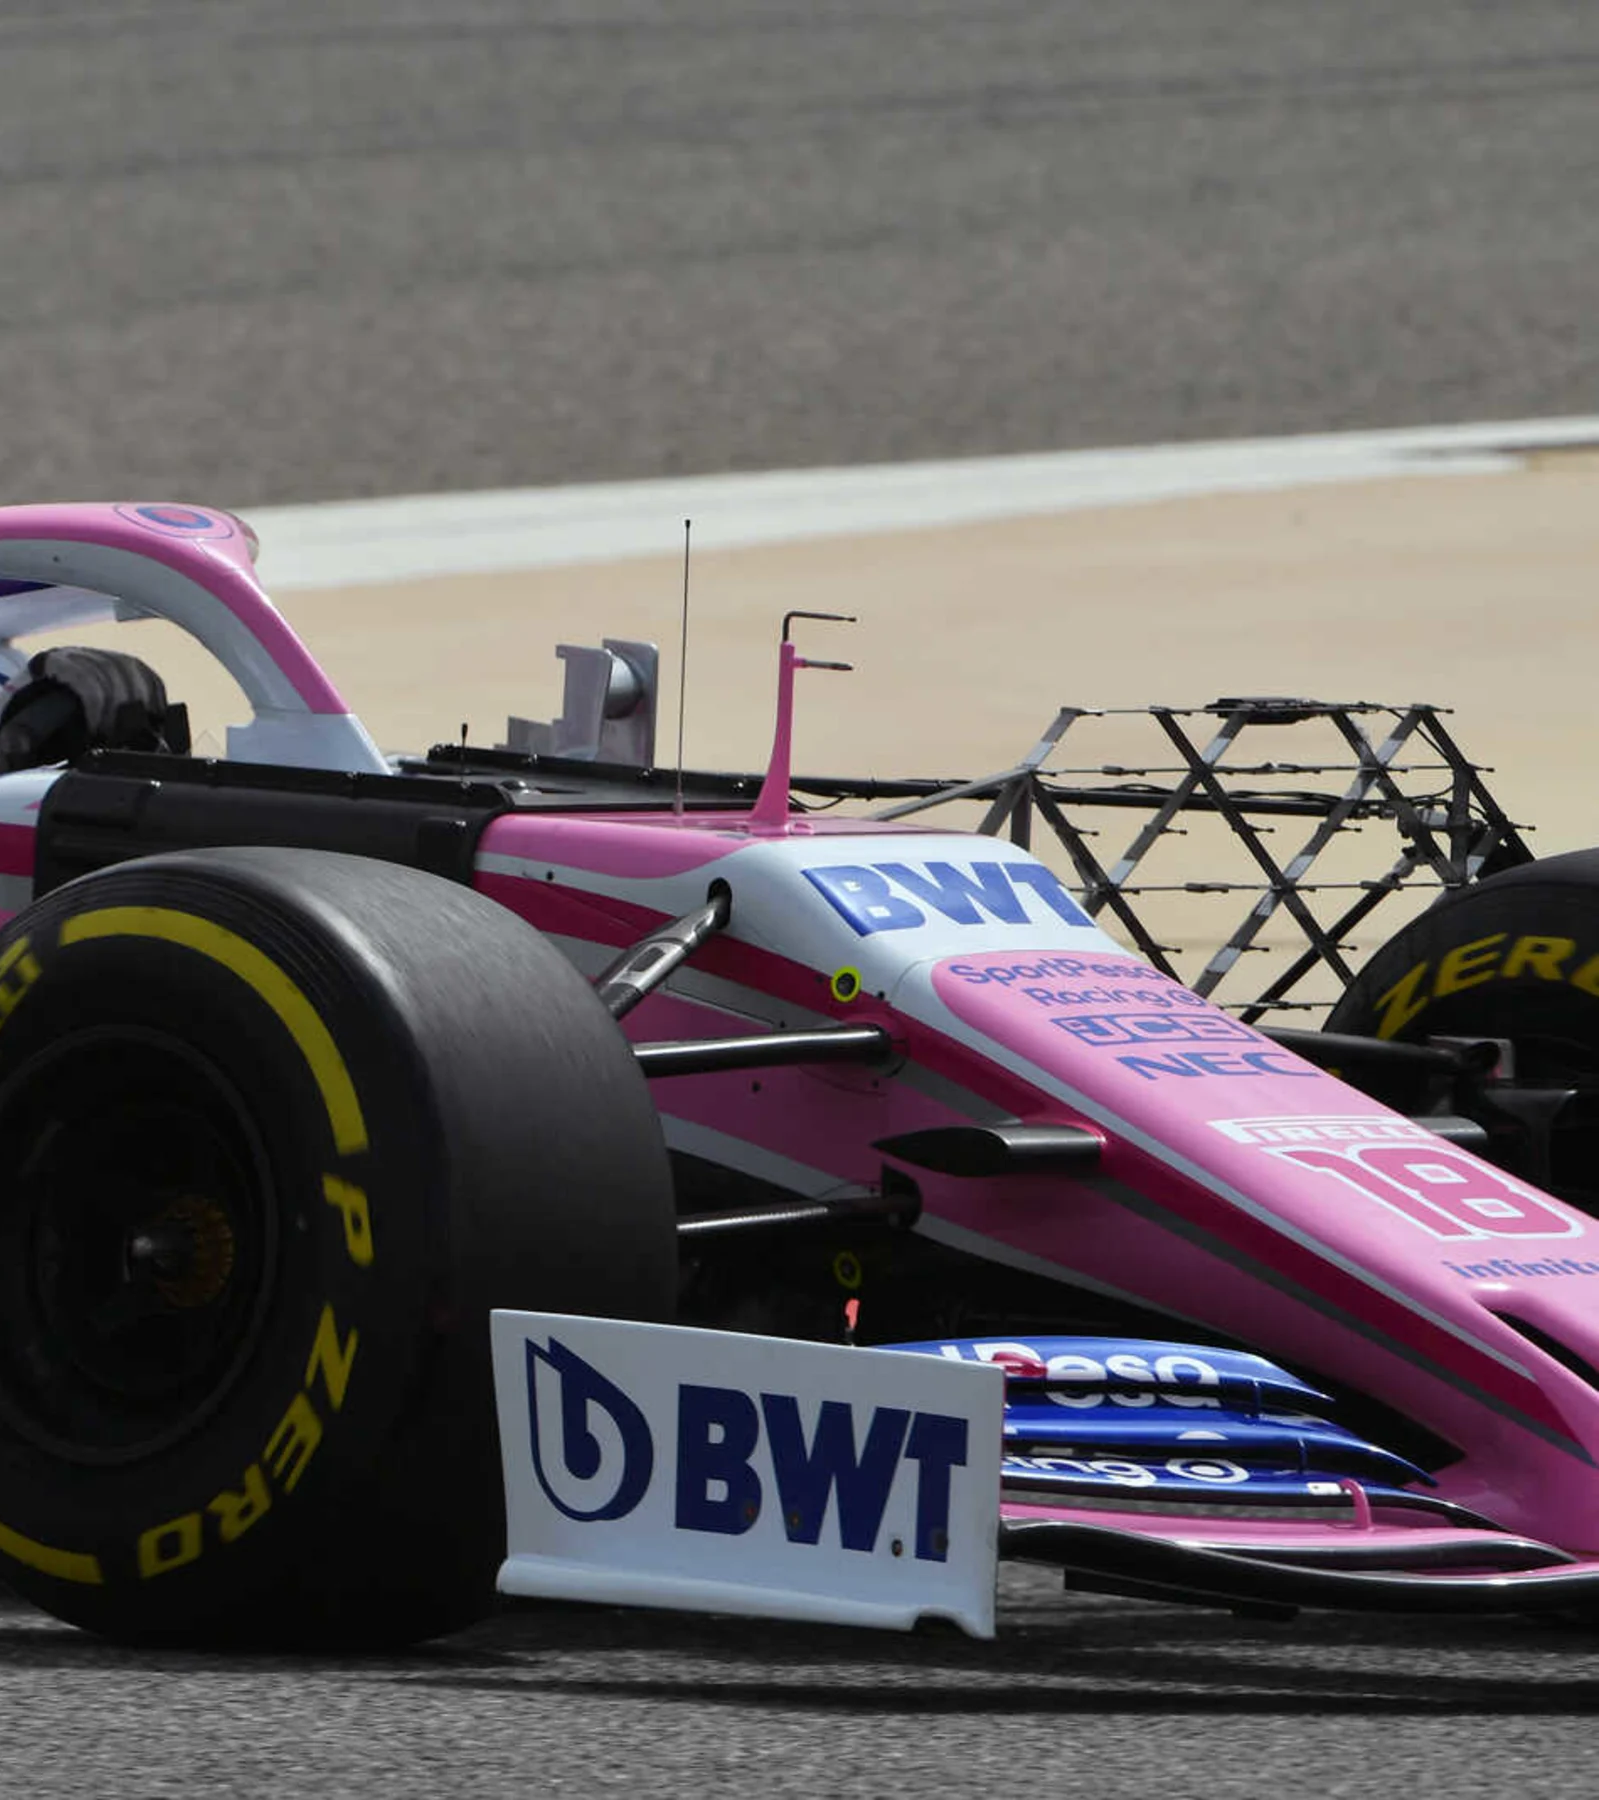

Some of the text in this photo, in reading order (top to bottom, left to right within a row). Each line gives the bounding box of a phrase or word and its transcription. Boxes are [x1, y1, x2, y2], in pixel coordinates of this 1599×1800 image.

[801, 862, 1097, 936] BWT
[949, 958, 1168, 987] SportPesa
[1021, 986, 1173, 1008] Racing
[1116, 1052, 1318, 1079] NEC
[1261, 1142, 1586, 1242] 18
[137, 1172, 374, 1580] P ZERO
[675, 1383, 969, 1563] BWT
